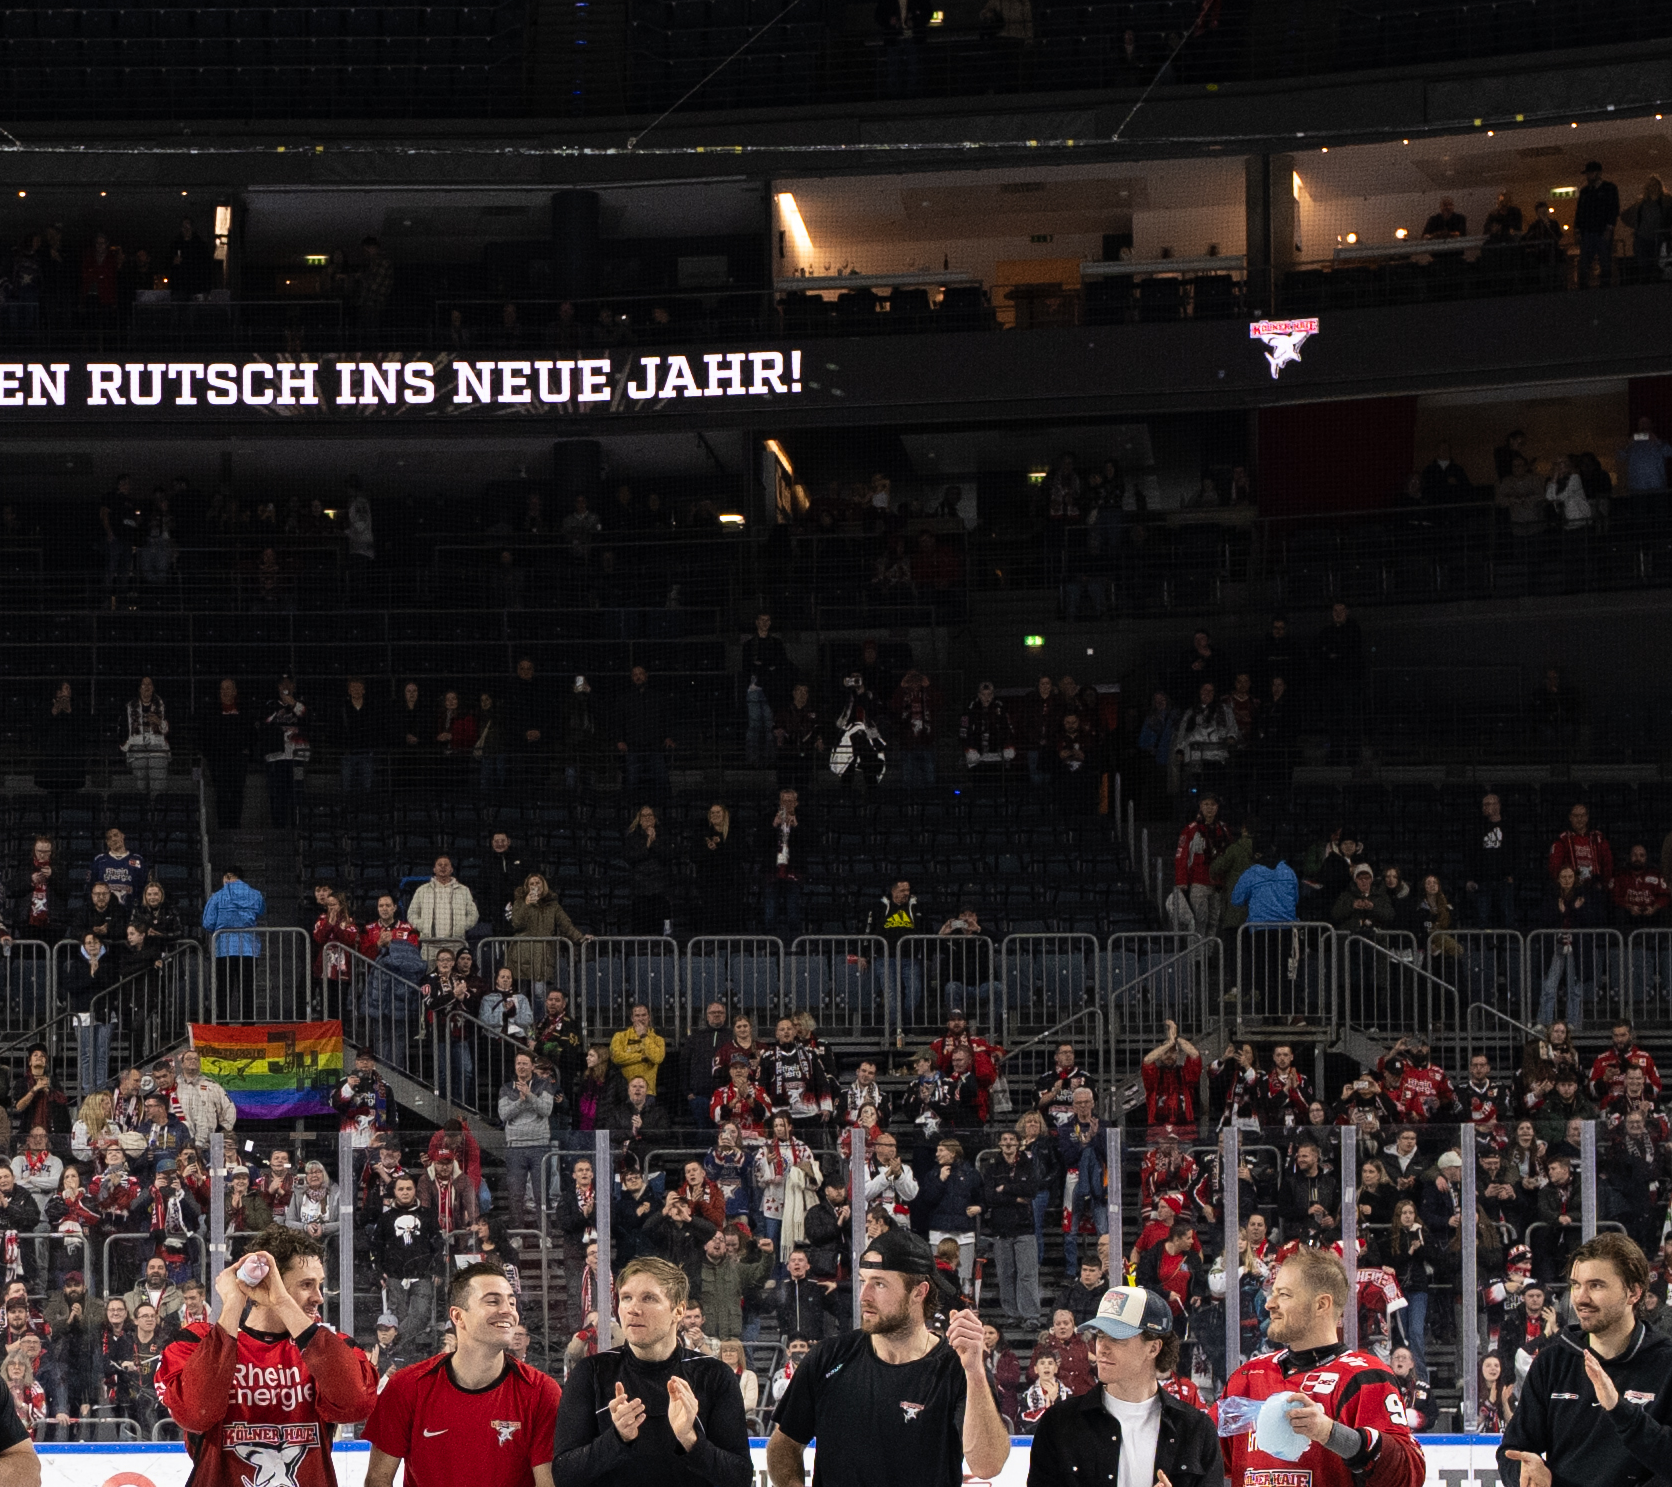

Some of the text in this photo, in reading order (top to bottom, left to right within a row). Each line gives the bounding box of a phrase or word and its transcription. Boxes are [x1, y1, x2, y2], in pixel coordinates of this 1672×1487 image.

[87, 363, 318, 405] RUTSCH
[336, 362, 434, 404] INS
[453, 359, 610, 403] NEUE
[628, 351, 801, 399] JAHR!
[230, 1363, 301, 1386] Rhein
[227, 1384, 314, 1412] Energie
[222, 1423, 317, 1447] KÖLNER HAIE
